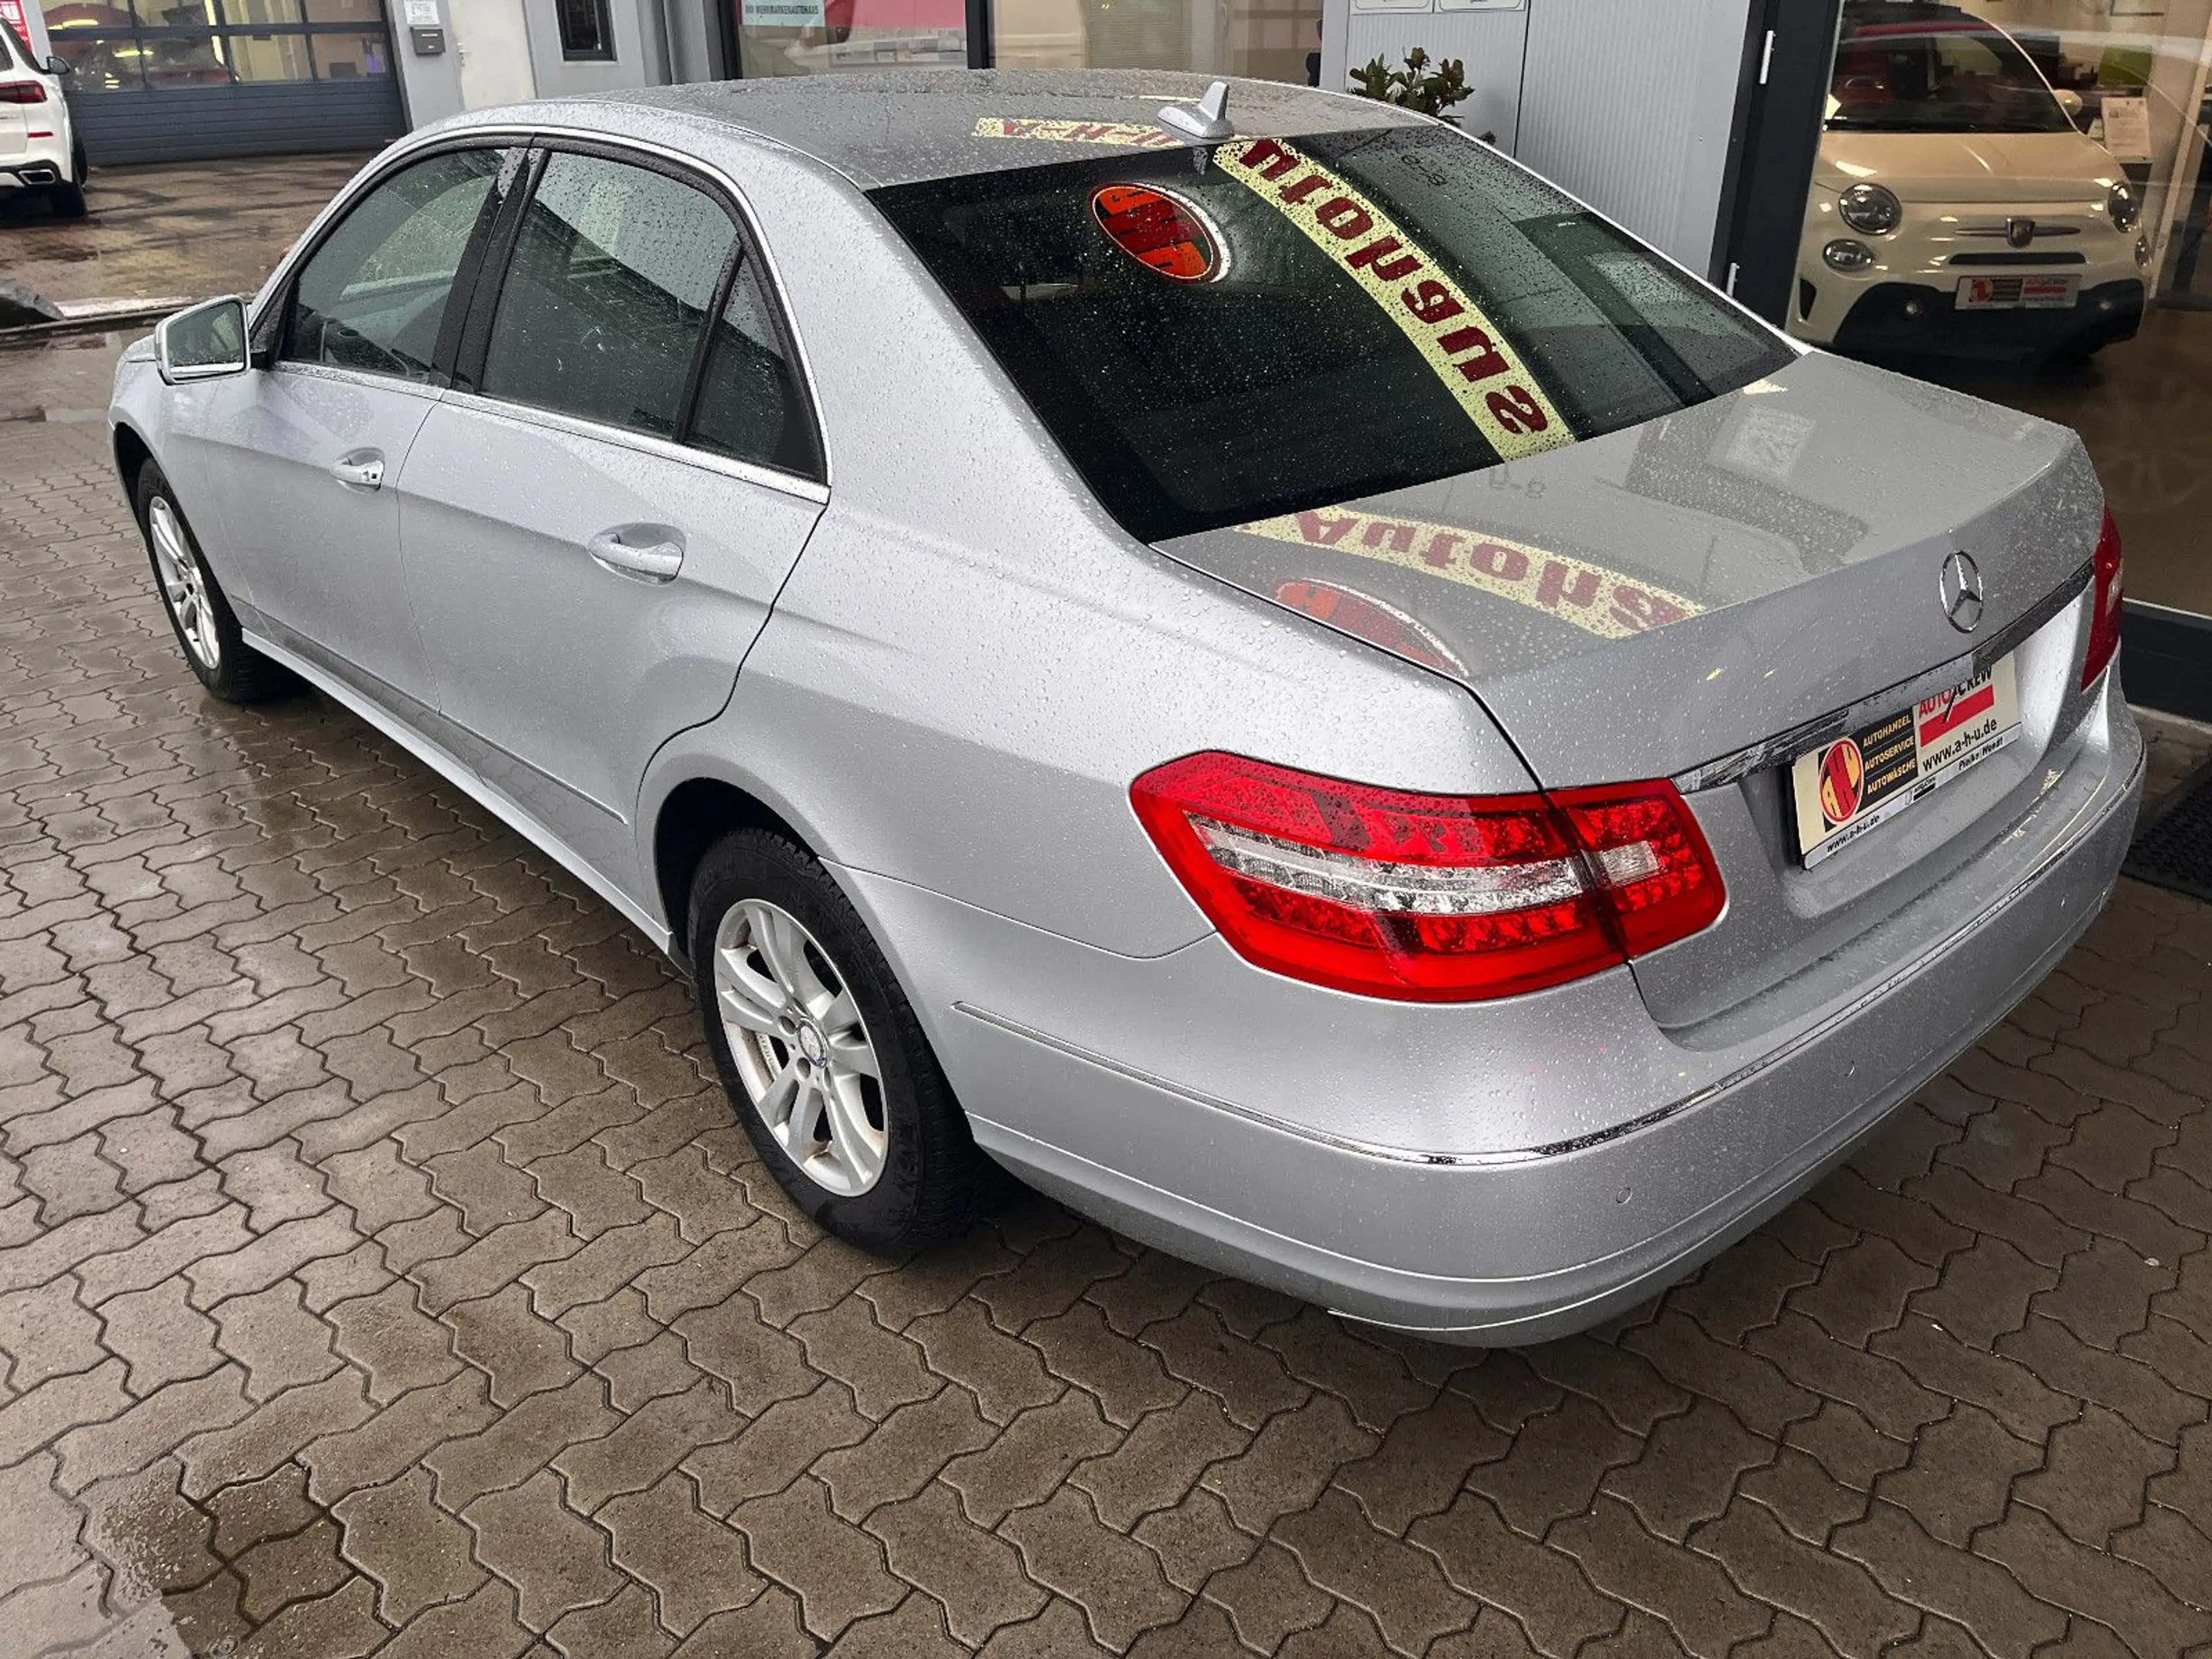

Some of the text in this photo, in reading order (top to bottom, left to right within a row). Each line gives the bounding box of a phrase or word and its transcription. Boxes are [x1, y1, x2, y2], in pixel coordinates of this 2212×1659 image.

[1863, 714, 1912, 748] AUTOHANDEL
[1922, 718, 1998, 772] www.a-h-u.de
[1865, 736, 1914, 771] AUTOSERVICE
